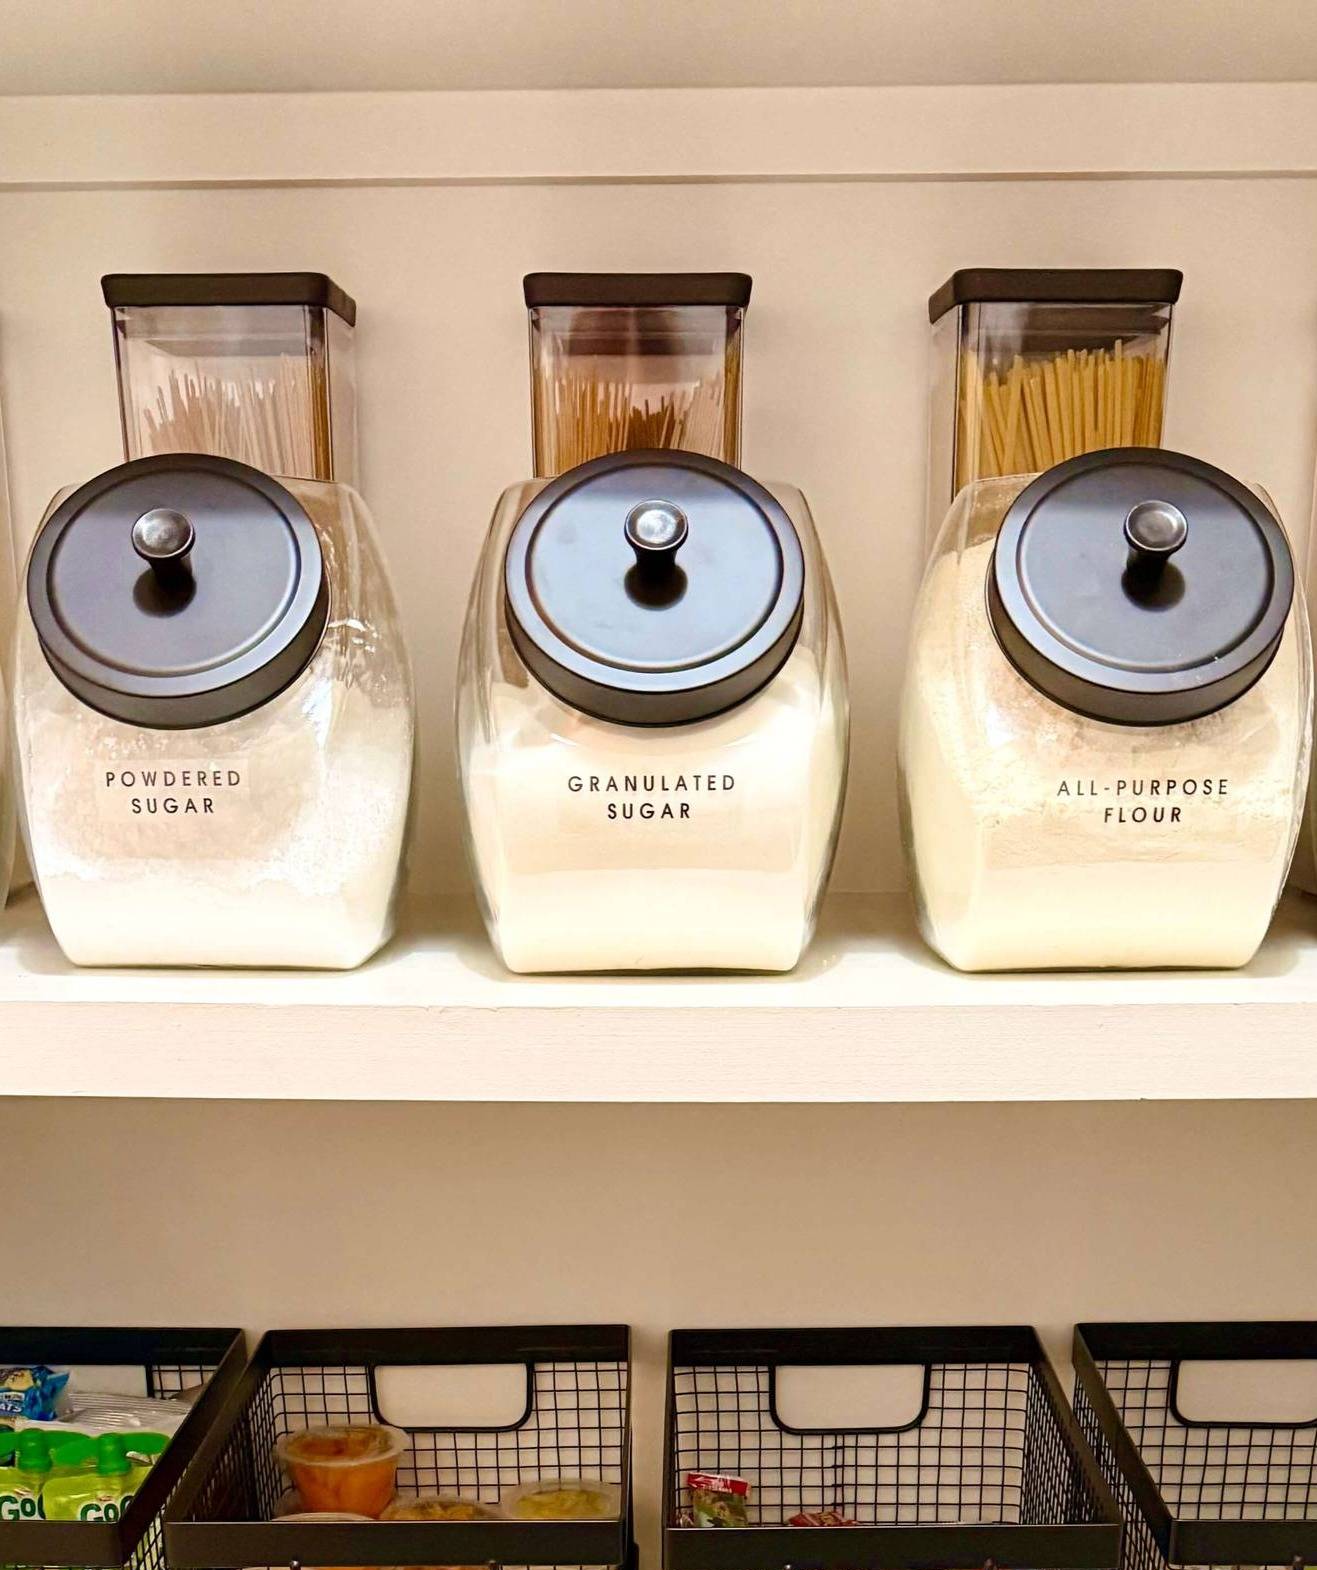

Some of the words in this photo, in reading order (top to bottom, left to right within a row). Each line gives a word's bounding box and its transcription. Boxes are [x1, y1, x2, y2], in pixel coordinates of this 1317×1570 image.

[105, 770, 242, 788] POWDERED
[567, 774, 736, 792] GRANULATED
[1056, 778, 1230, 797] ALL-PURPOSE
[131, 797, 215, 815] SUGAR
[606, 802, 691, 821] SUGAR
[1103, 806, 1183, 825] FLOUR
